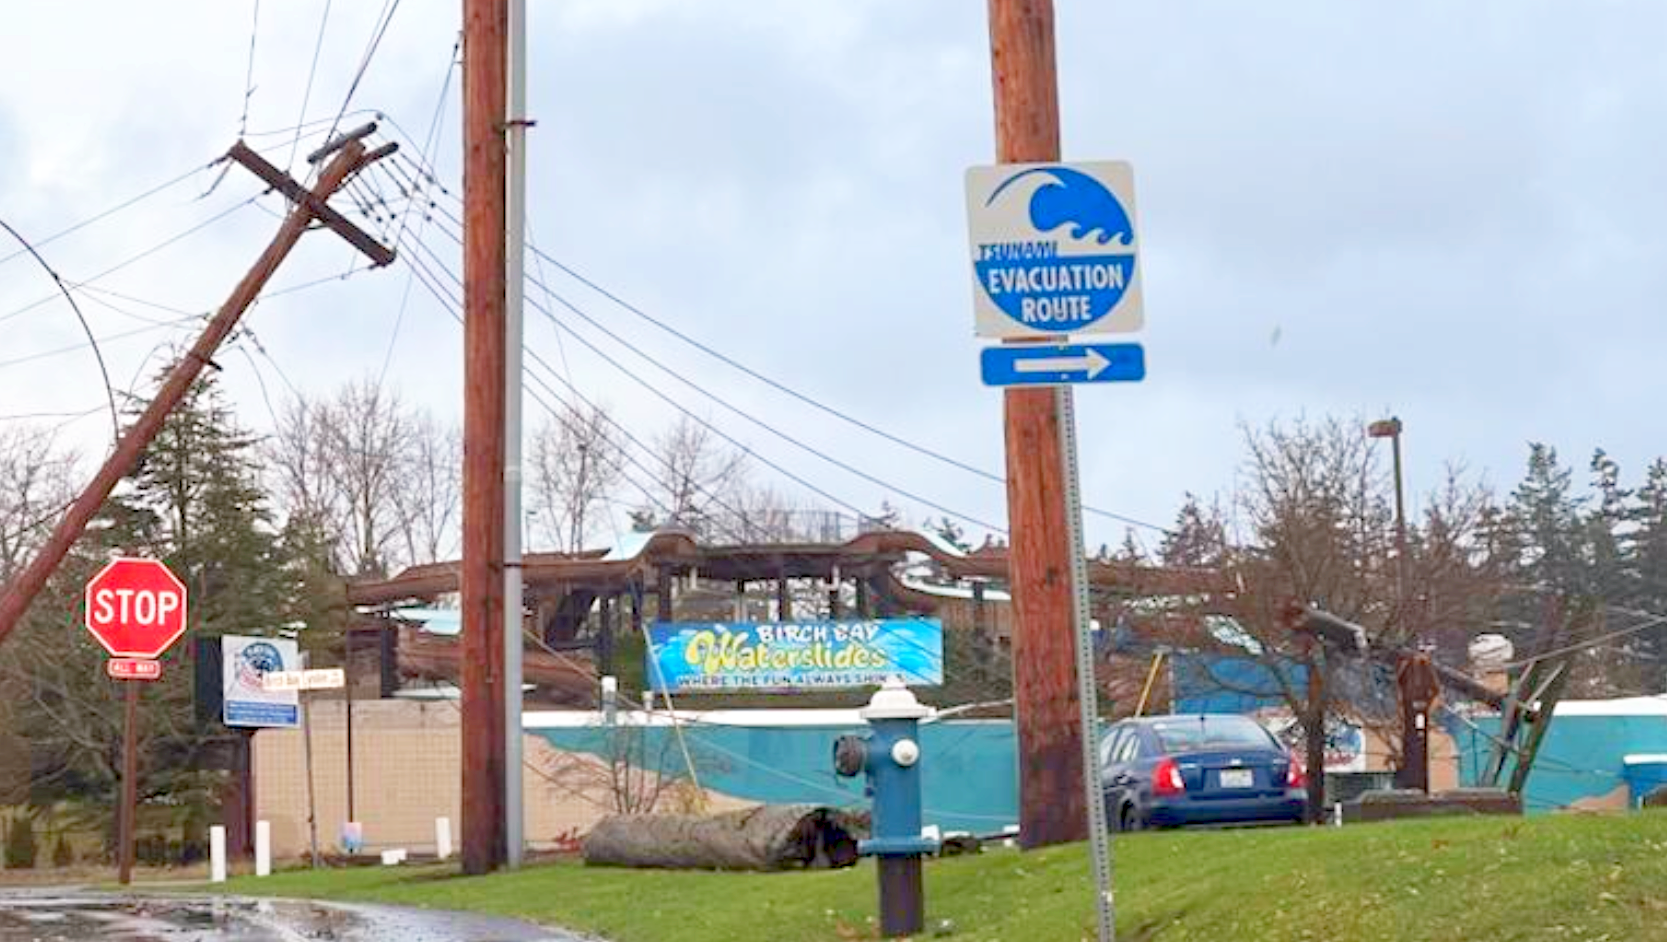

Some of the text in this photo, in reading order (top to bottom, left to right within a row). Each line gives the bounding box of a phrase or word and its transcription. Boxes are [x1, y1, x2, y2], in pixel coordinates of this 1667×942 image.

[978, 239, 1058, 261] TSUNAMI
[987, 262, 1124, 294] EVACUATION
[1020, 295, 1092, 324] ROUTE
[94, 589, 178, 625] STOP
[756, 622, 880, 643] BIRCH BAY
[684, 629, 886, 676] Waterslides
[679, 675, 729, 687] WHERE
[732, 675, 758, 686] THE
[763, 674, 792, 685] FUN
[797, 673, 851, 685] ALWAYS
